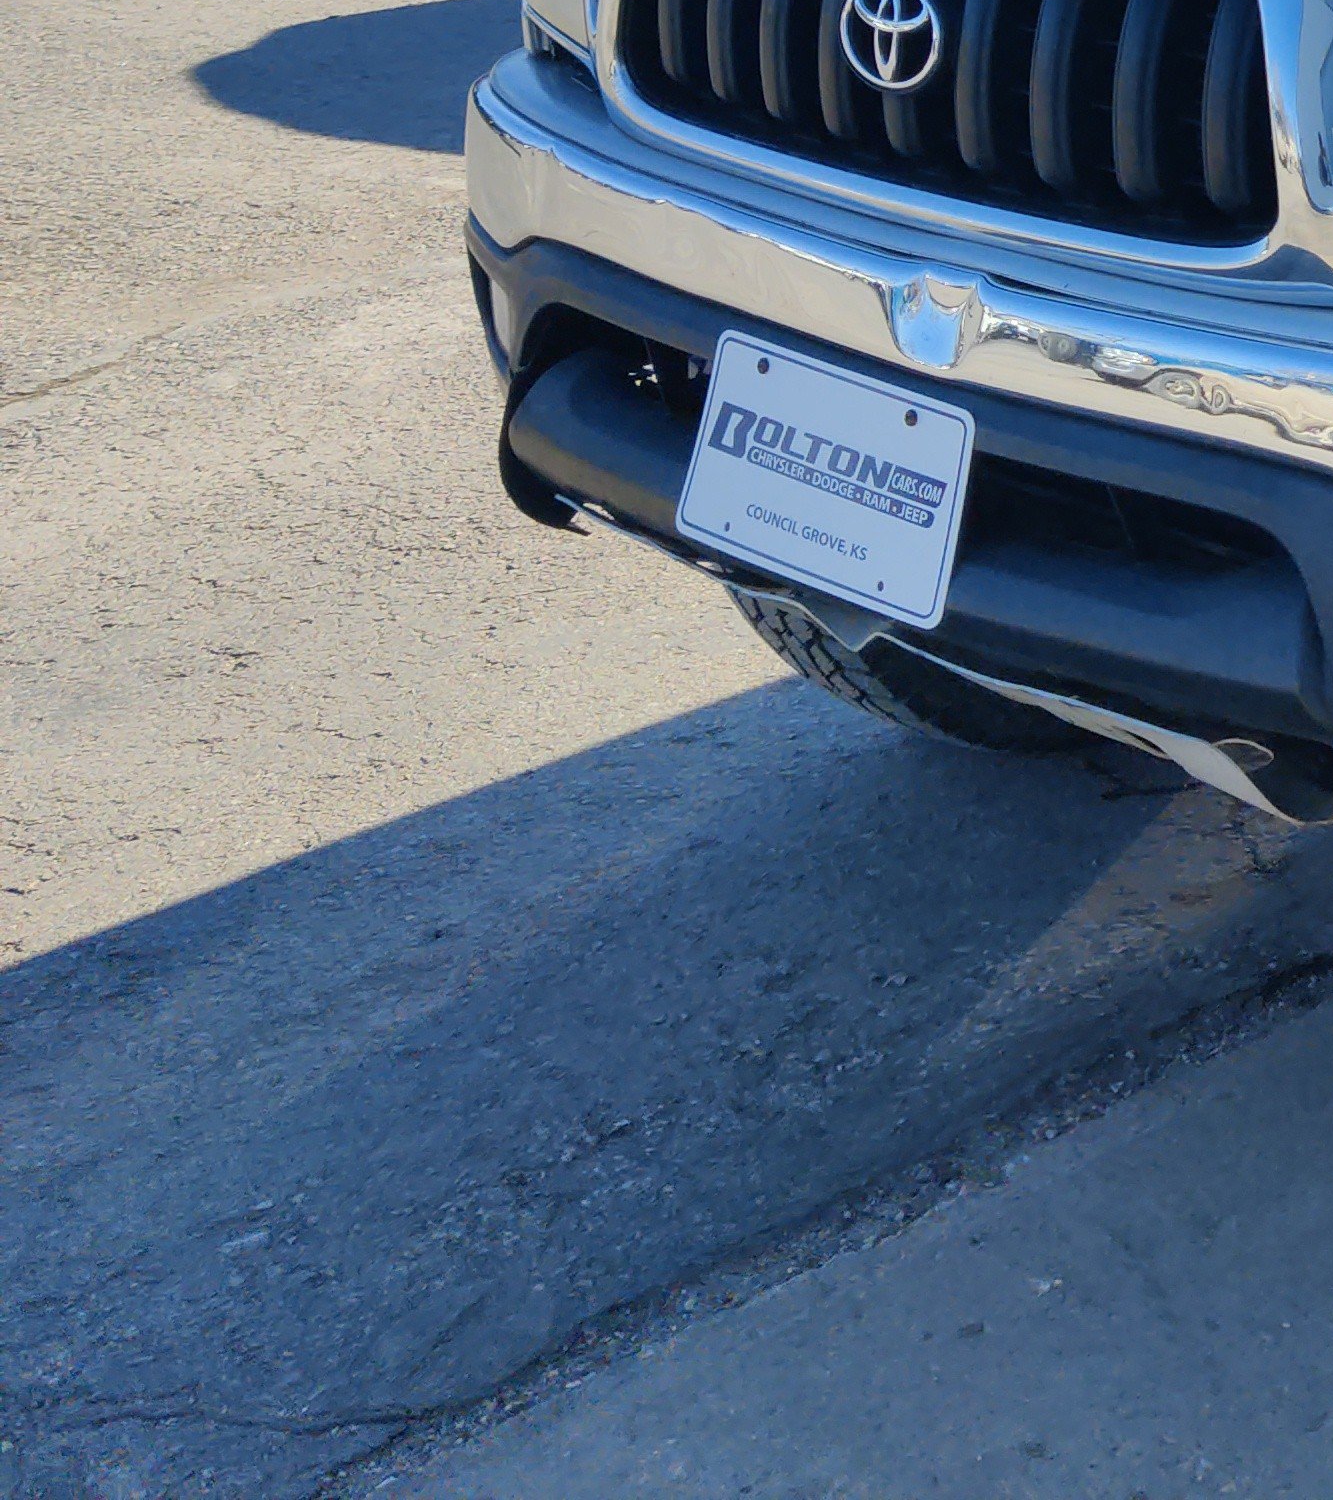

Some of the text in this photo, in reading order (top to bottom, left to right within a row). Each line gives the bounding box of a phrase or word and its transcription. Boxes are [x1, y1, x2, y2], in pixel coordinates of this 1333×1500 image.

[708, 401, 943, 504] BOLTON CARS.COM
[750, 448, 929, 525] CHRYSLER DODGE RAM JEEP
[746, 504, 869, 561] COUNCIL GROVE, KS
